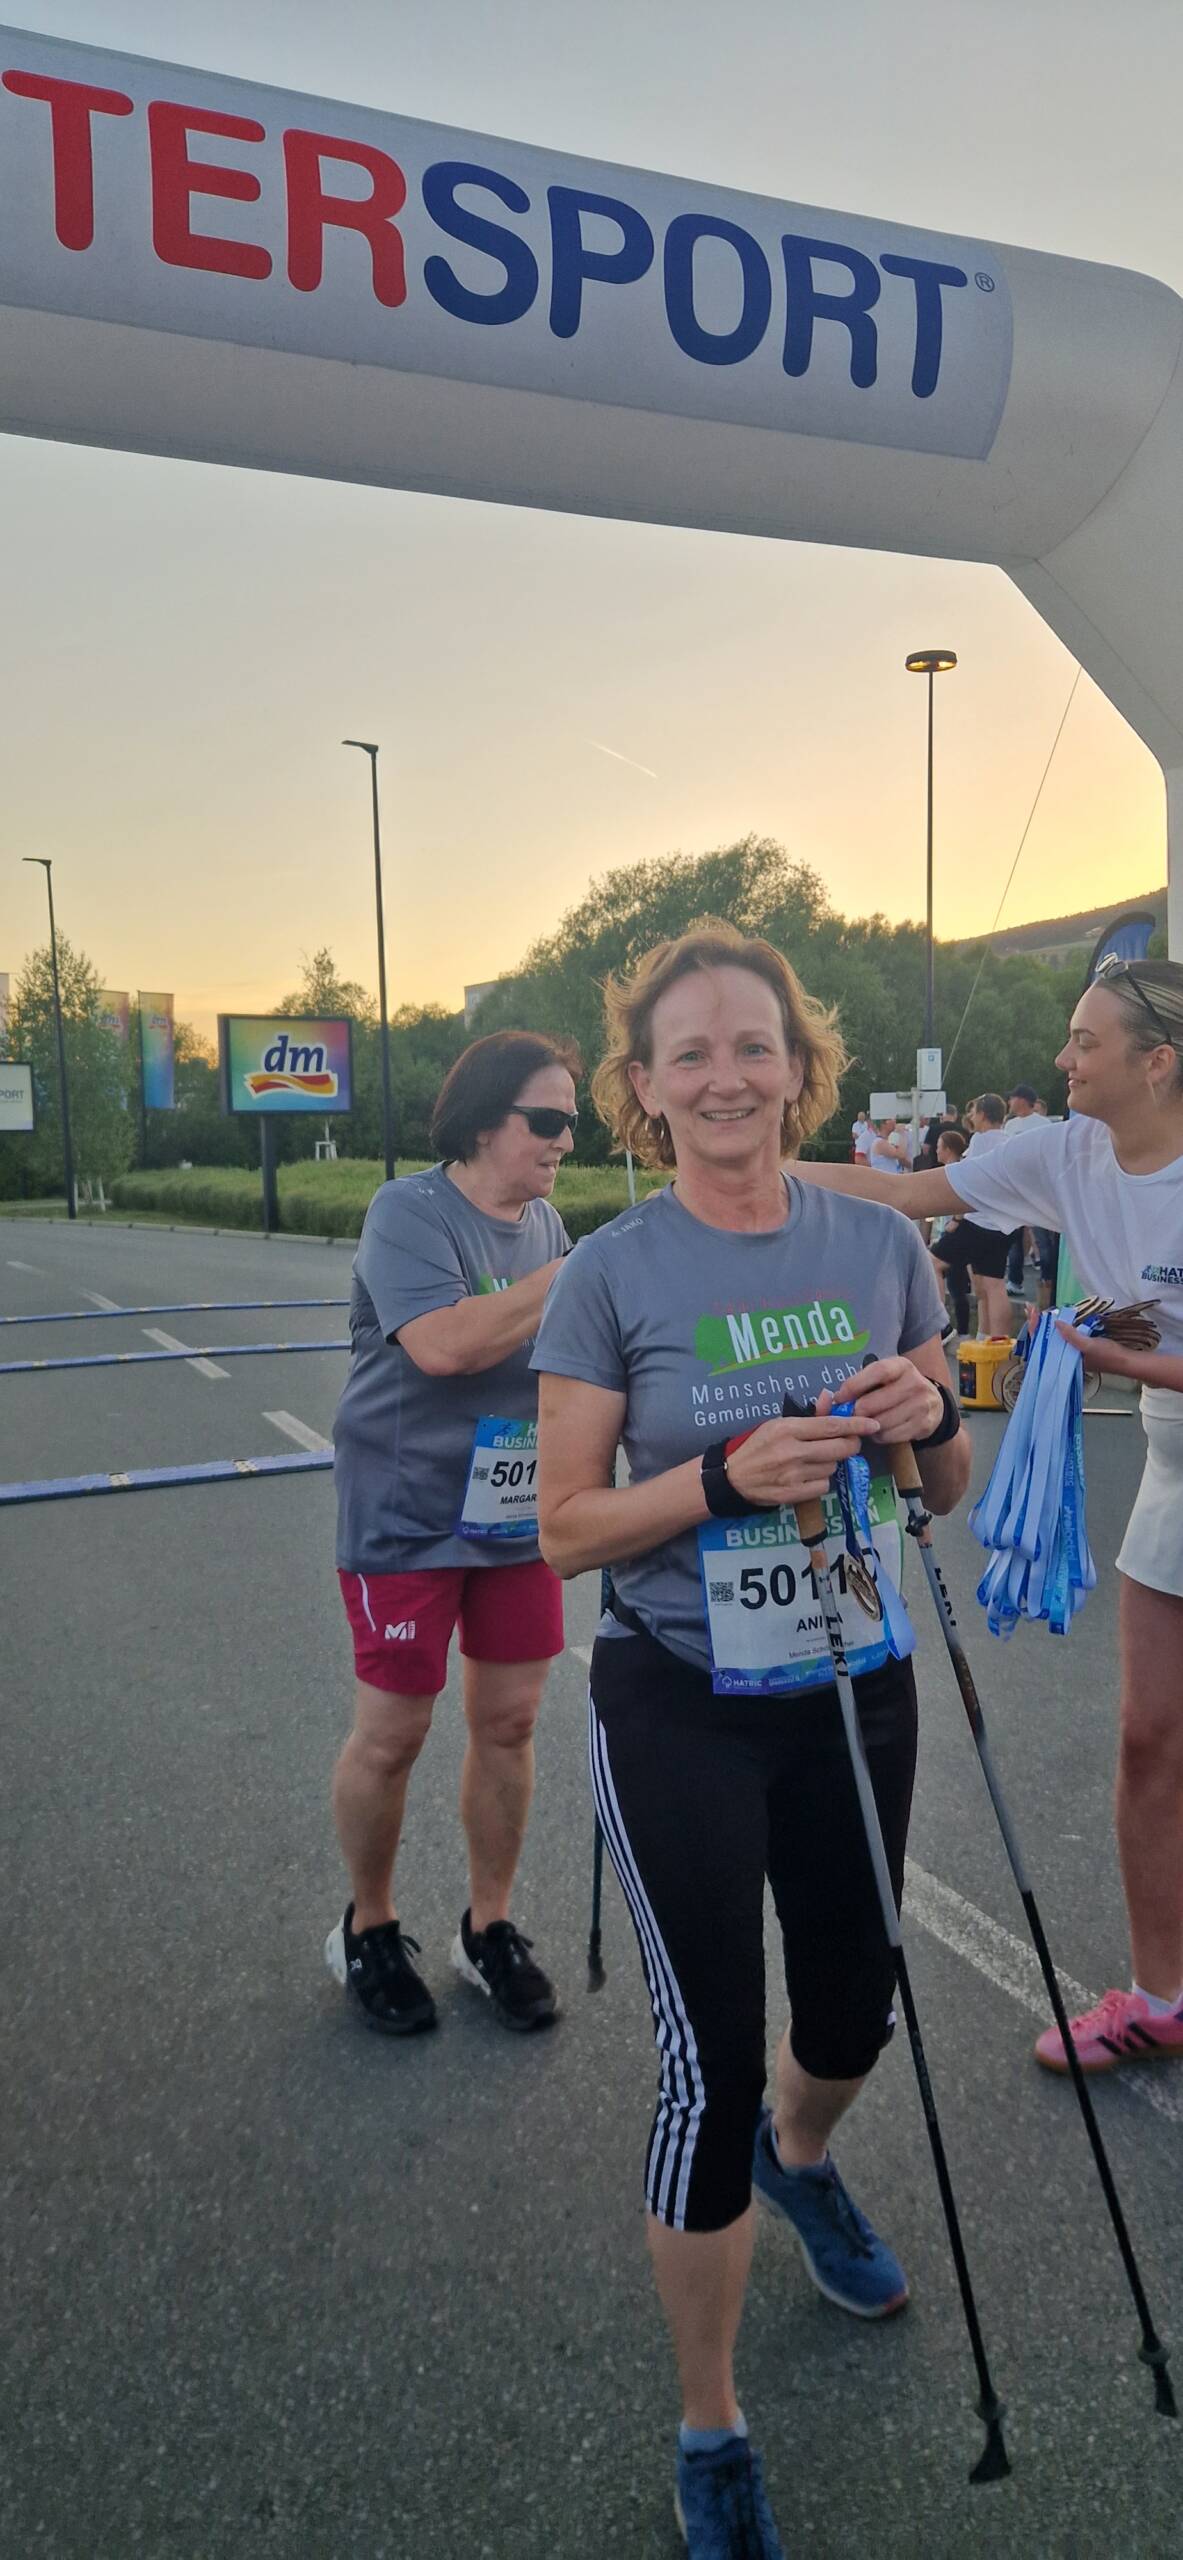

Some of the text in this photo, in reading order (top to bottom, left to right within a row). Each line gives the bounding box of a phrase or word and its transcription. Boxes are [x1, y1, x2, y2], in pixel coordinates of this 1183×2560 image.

[264, 1035, 324, 1072] dm
[726, 1301, 854, 1364] Menda
[692, 1374, 809, 1405] Menschen
[826, 1615, 849, 1677] LEKI
